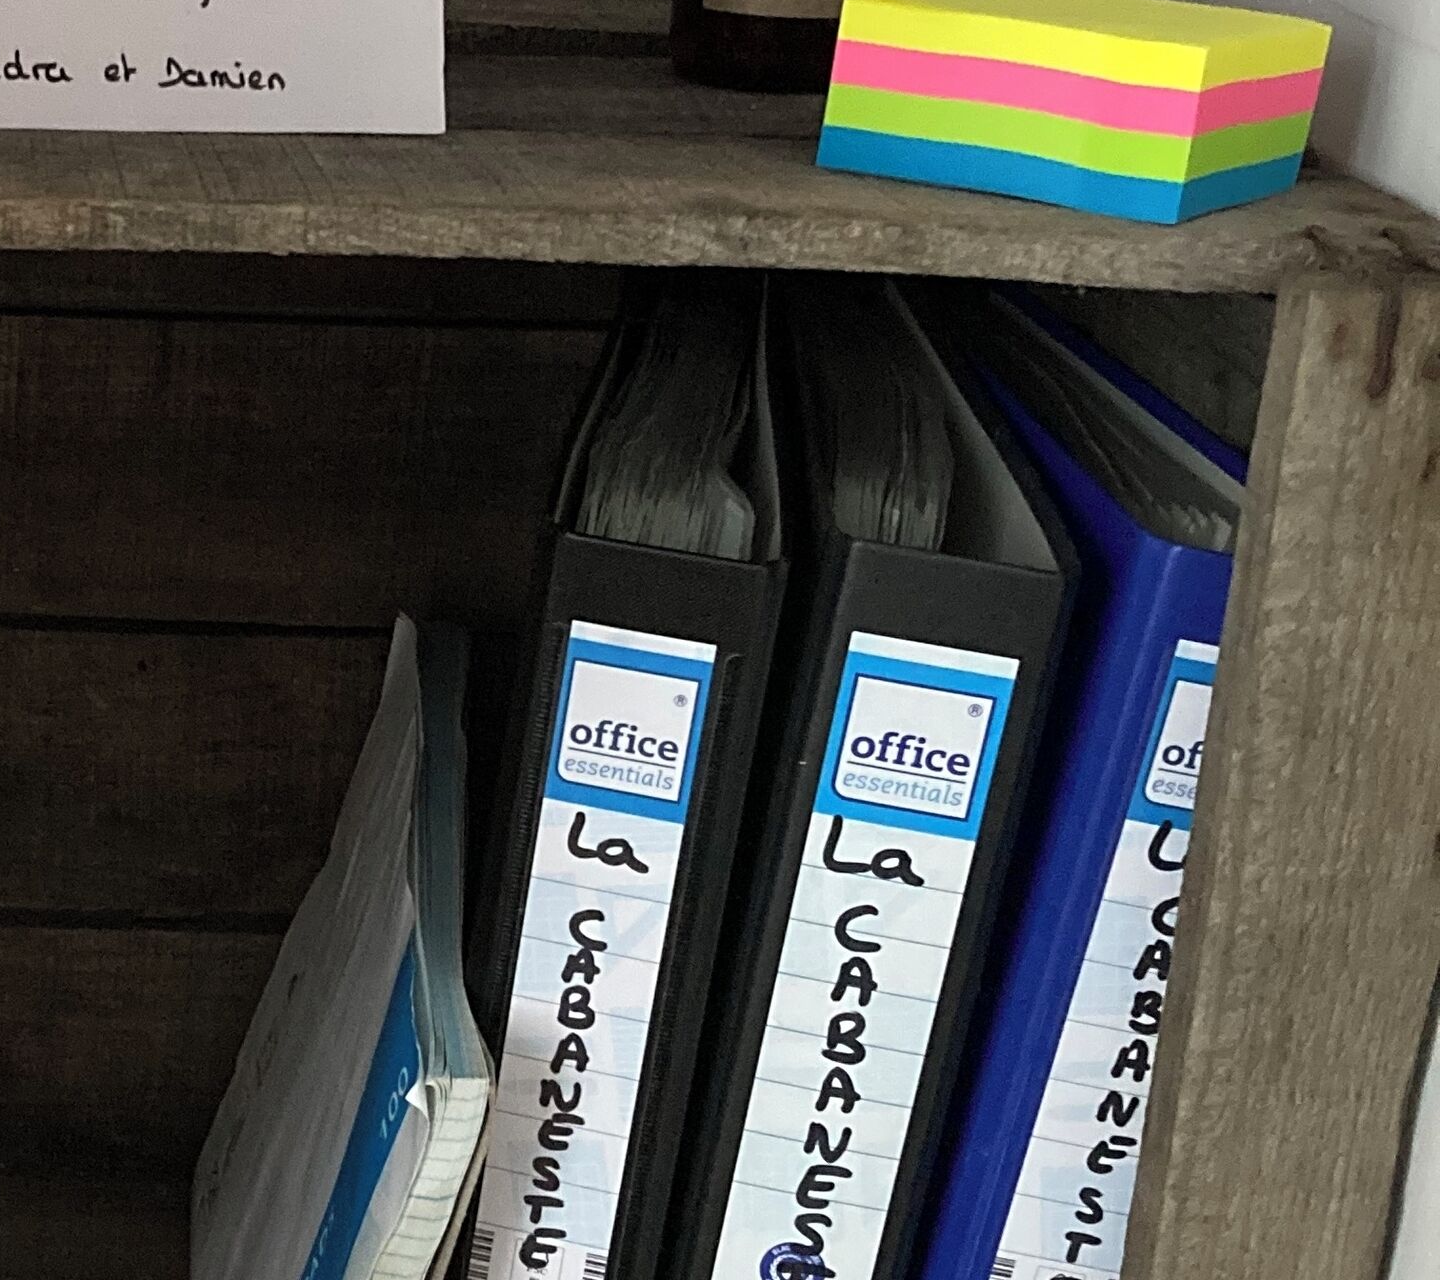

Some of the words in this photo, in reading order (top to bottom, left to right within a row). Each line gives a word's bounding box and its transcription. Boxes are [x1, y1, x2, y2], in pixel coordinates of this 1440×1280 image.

[104, 53, 138, 83] et
[158, 56, 287, 91] Damien
[569, 719, 680, 762] office
[850, 731, 971, 777] office
[563, 756, 674, 791] essentials
[842, 770, 963, 807] essentials
[379, 1066, 409, 1140] 100
[518, 909, 608, 1269] CABANESTE
